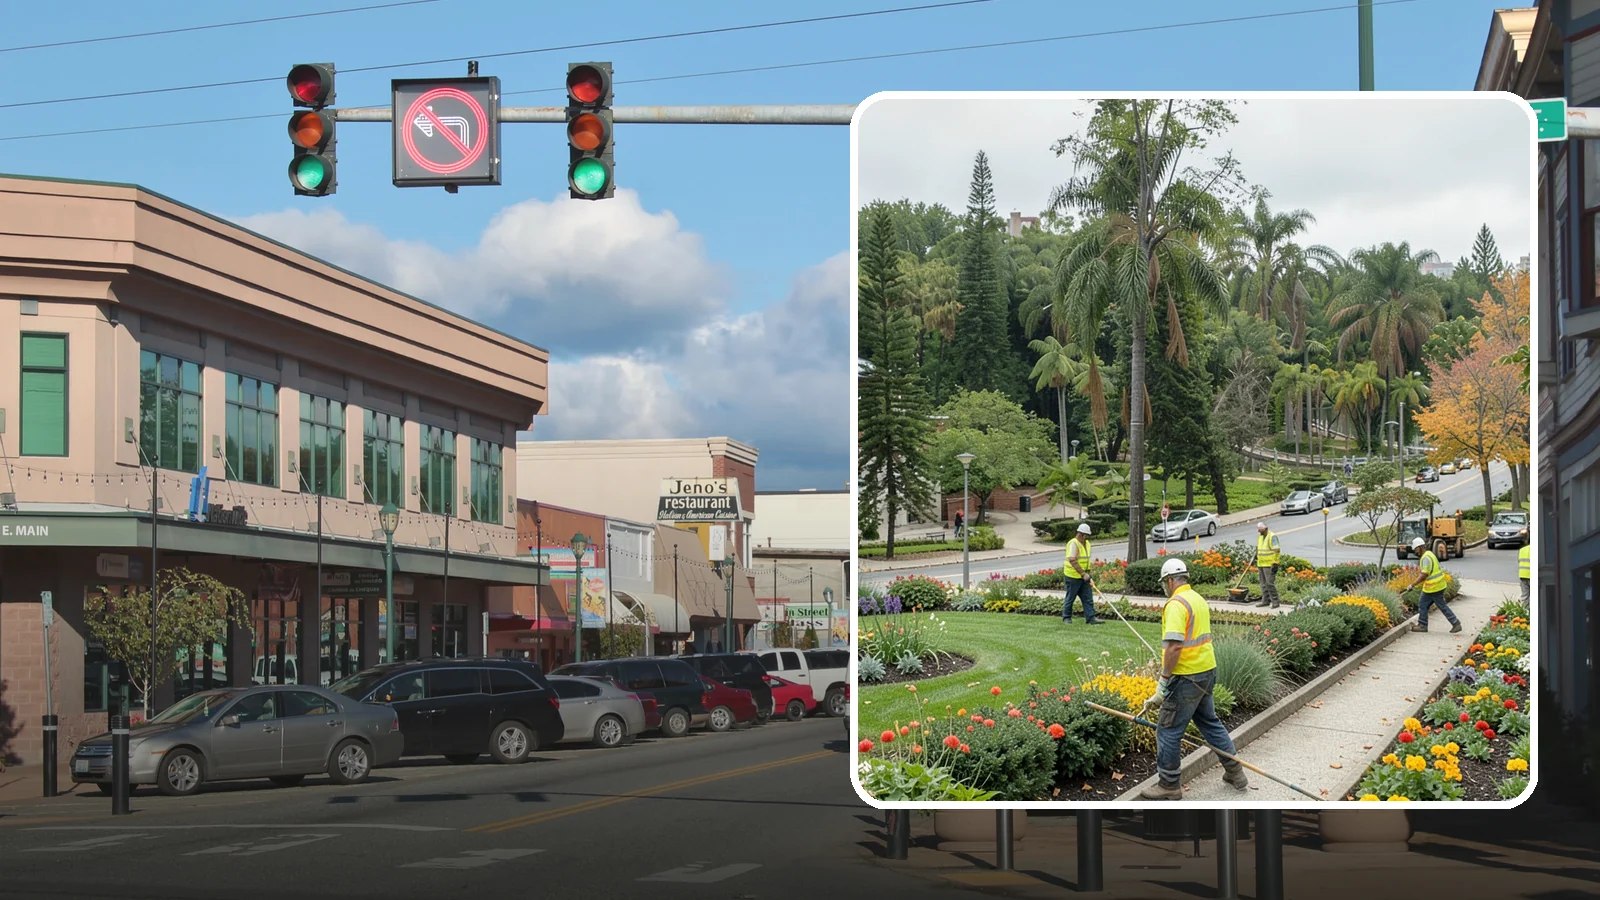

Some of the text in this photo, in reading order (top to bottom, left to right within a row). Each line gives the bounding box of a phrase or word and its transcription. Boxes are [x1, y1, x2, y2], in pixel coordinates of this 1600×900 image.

[669, 480, 728, 494] Jeno's
[665, 496, 731, 509] restaurant
[658, 510, 681, 520] Italian
[686, 509, 714, 519] American
[715, 509, 737, 519] Cuisine
[2, 525, 49, 536] E. MAIN
[797, 607, 828, 616] Street
[791, 619, 823, 627] lass
